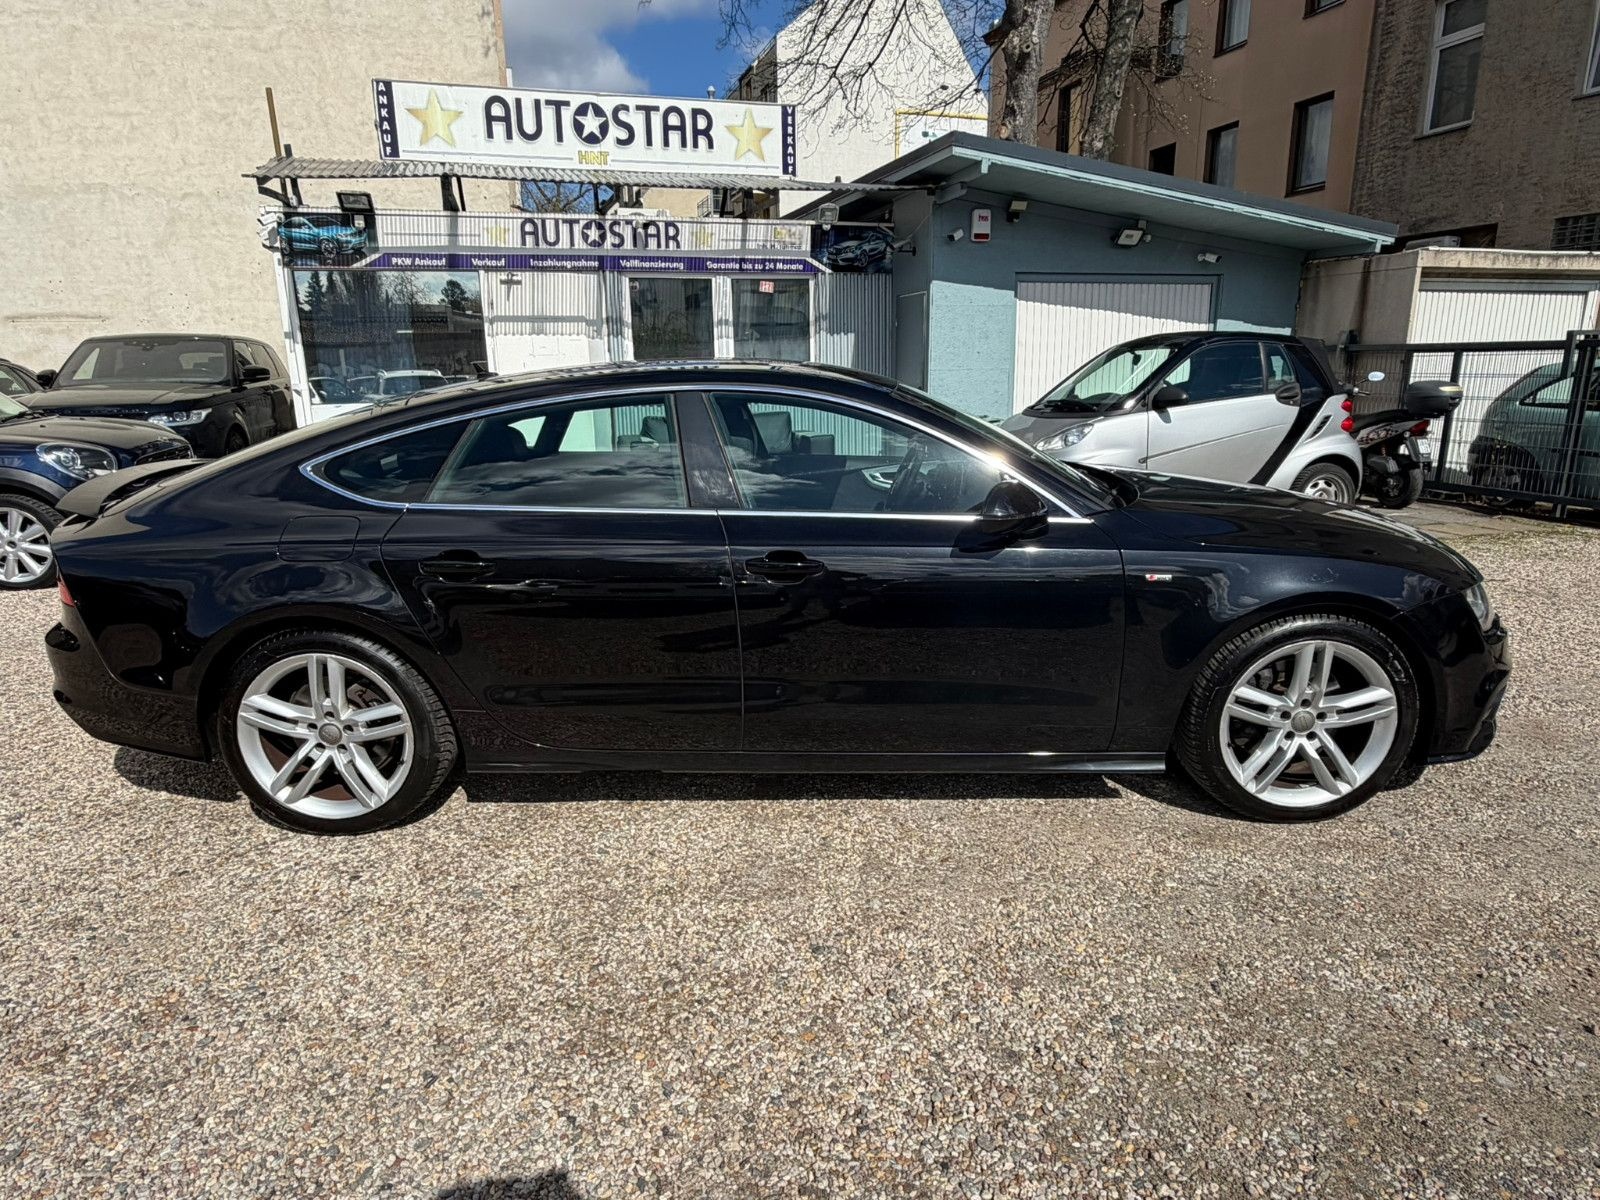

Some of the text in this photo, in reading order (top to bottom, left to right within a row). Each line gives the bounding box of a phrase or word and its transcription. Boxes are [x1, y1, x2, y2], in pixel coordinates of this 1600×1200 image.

[378, 82, 391, 156] ANKAUF
[484, 94, 715, 150] AUTOSTAR
[786, 106, 795, 174] VERKAUF
[577, 150, 609, 165] HNT
[520, 218, 681, 249] AUTOSTAR
[391, 257, 446, 266] PKW Ankauf
[471, 258, 506, 267] Verkauf
[530, 258, 599, 268] Inzahlungnahme
[619, 259, 684, 270] Vollfinanzierung
[706, 261, 740, 270] Garantie
[741, 261, 753, 270] bis
[765, 261, 775, 270] 24
[776, 262, 804, 270] Monate
